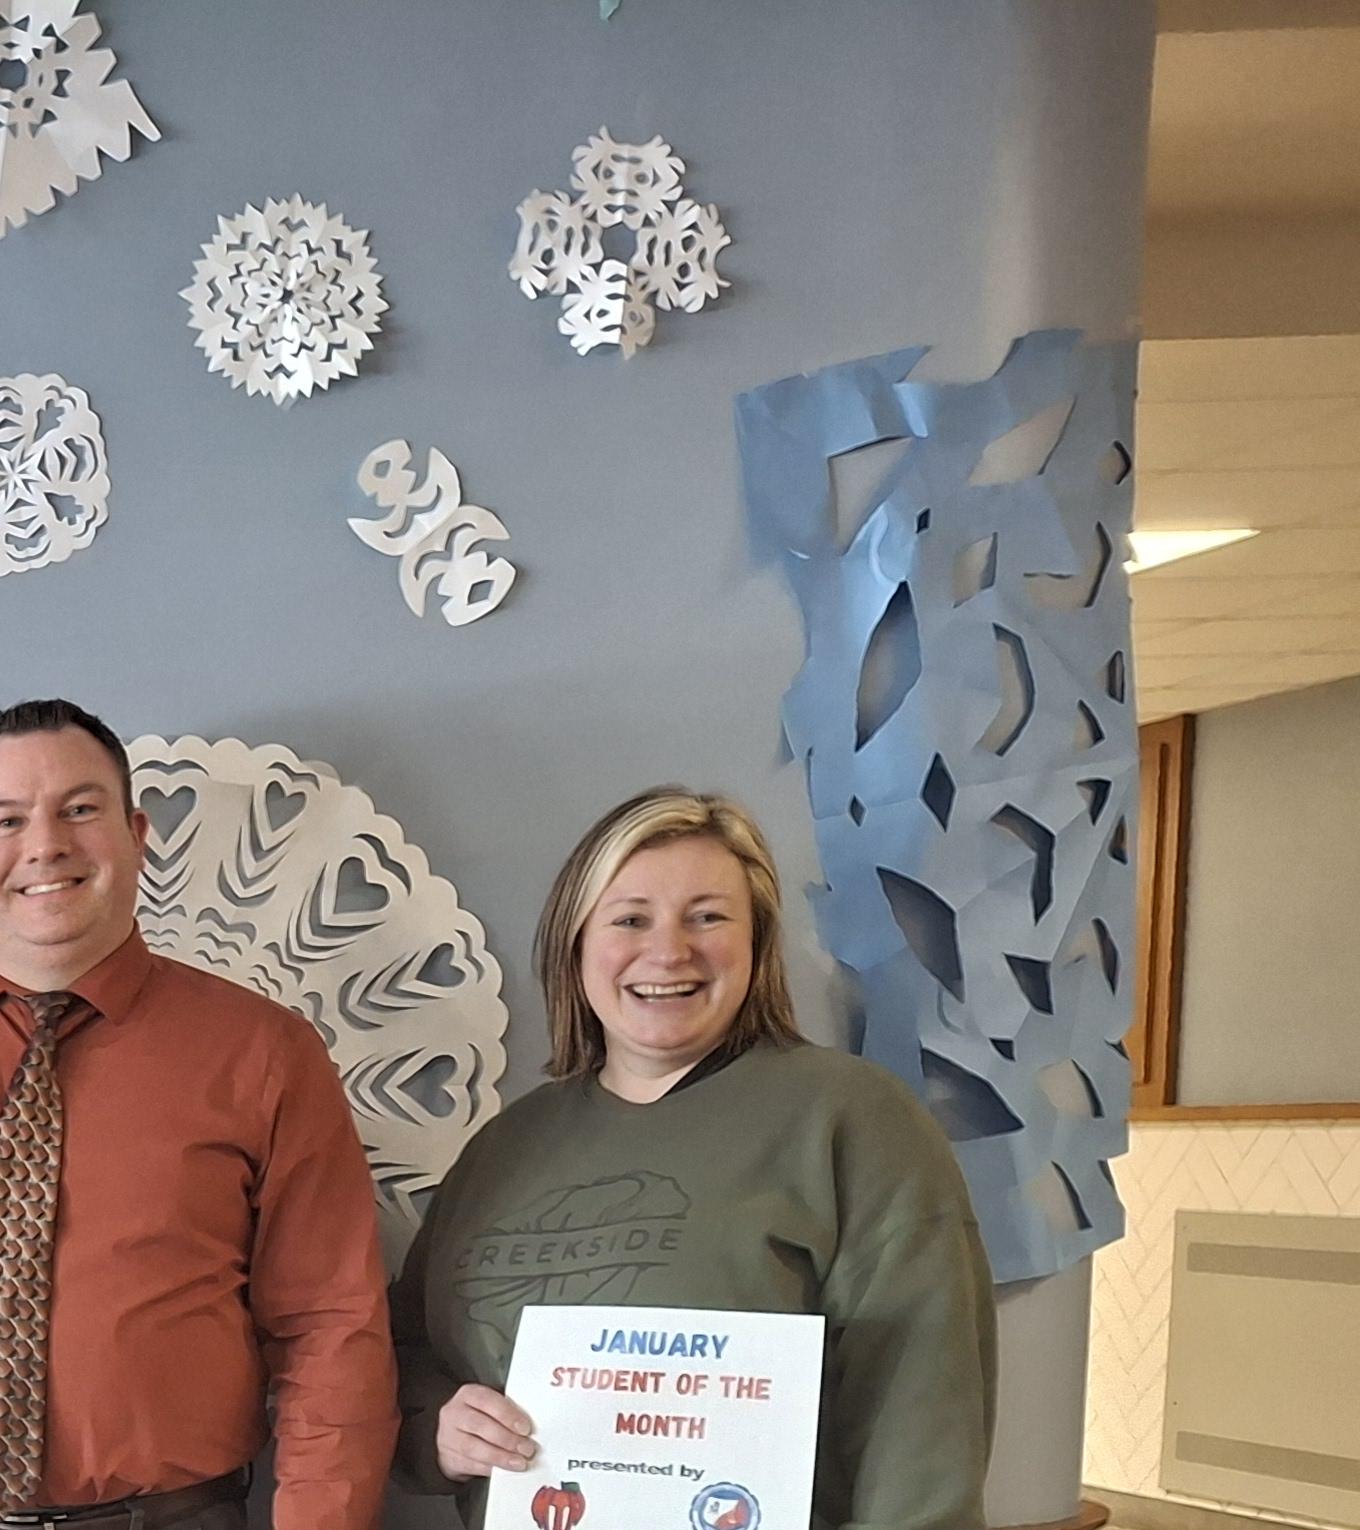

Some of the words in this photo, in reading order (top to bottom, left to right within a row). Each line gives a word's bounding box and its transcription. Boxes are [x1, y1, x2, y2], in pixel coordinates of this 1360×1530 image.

[456, 1228, 684, 1270] CREEKSIDE
[590, 1328, 730, 1360] JANUARY
[550, 1366, 666, 1394] STUDENT
[676, 1373, 709, 1397] OF
[720, 1376, 773, 1400] THE
[615, 1413, 707, 1440] MONTH
[567, 1457, 674, 1478] presented
[679, 1463, 706, 1481] by
